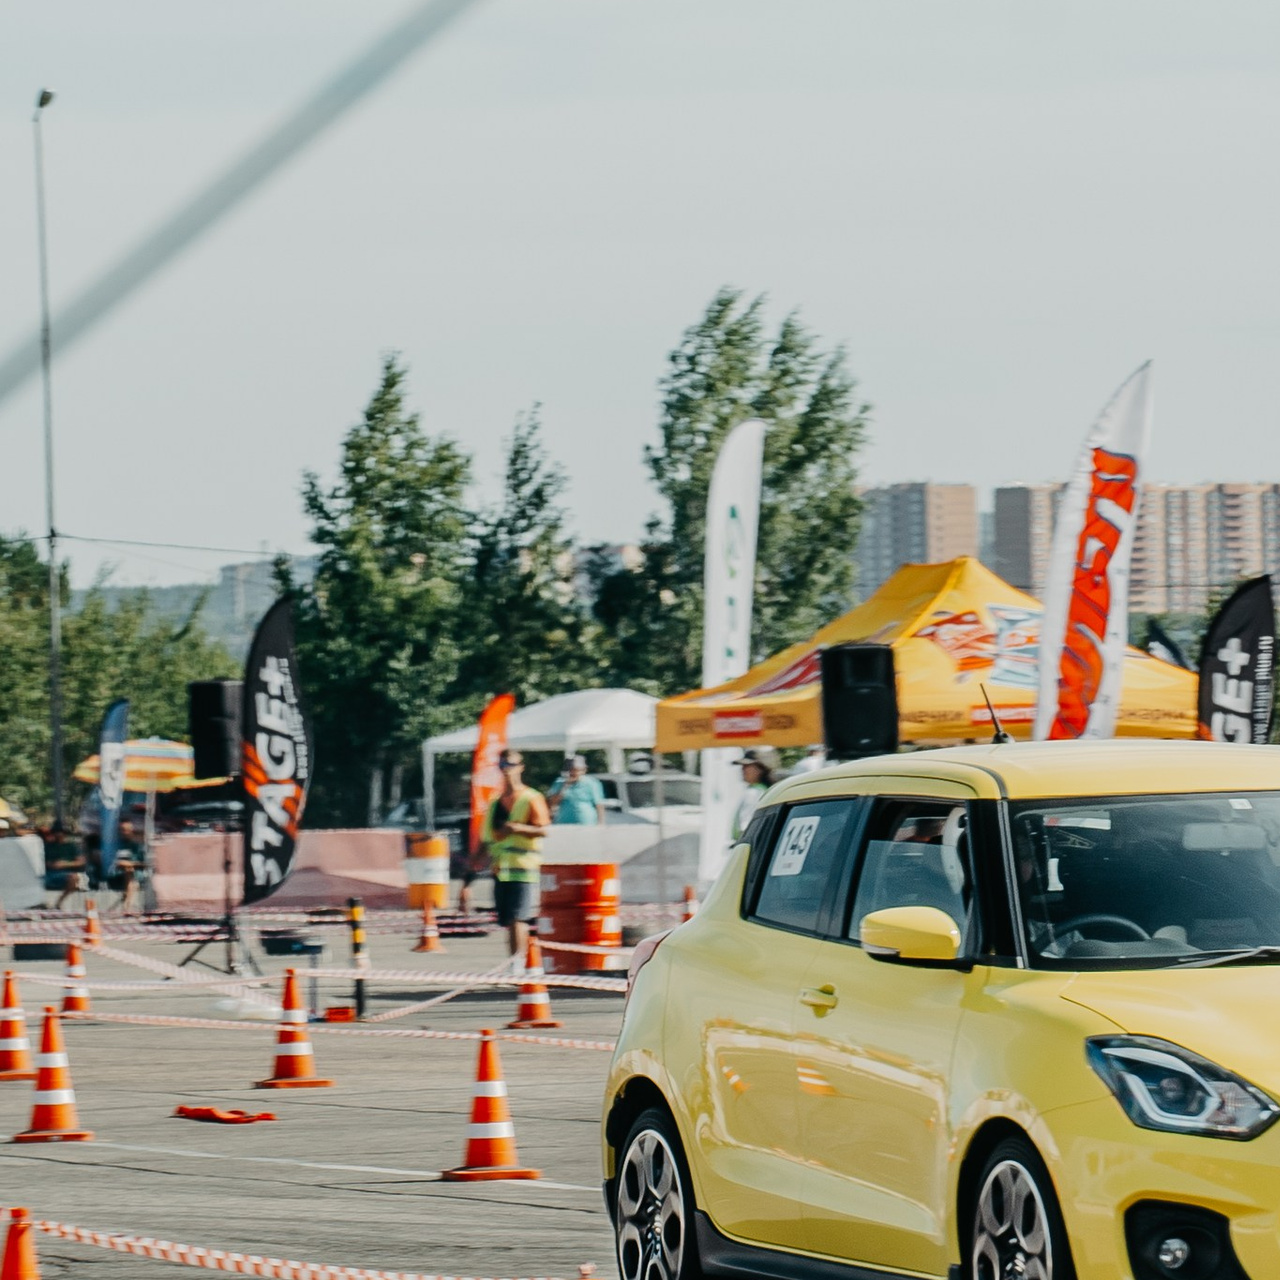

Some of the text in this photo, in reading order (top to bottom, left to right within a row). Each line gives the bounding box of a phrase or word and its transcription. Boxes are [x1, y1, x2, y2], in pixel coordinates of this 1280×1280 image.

[1211, 637, 1254, 743] GE+
[251, 655, 297, 886] STAGE+
[782, 824, 813, 856] 143
